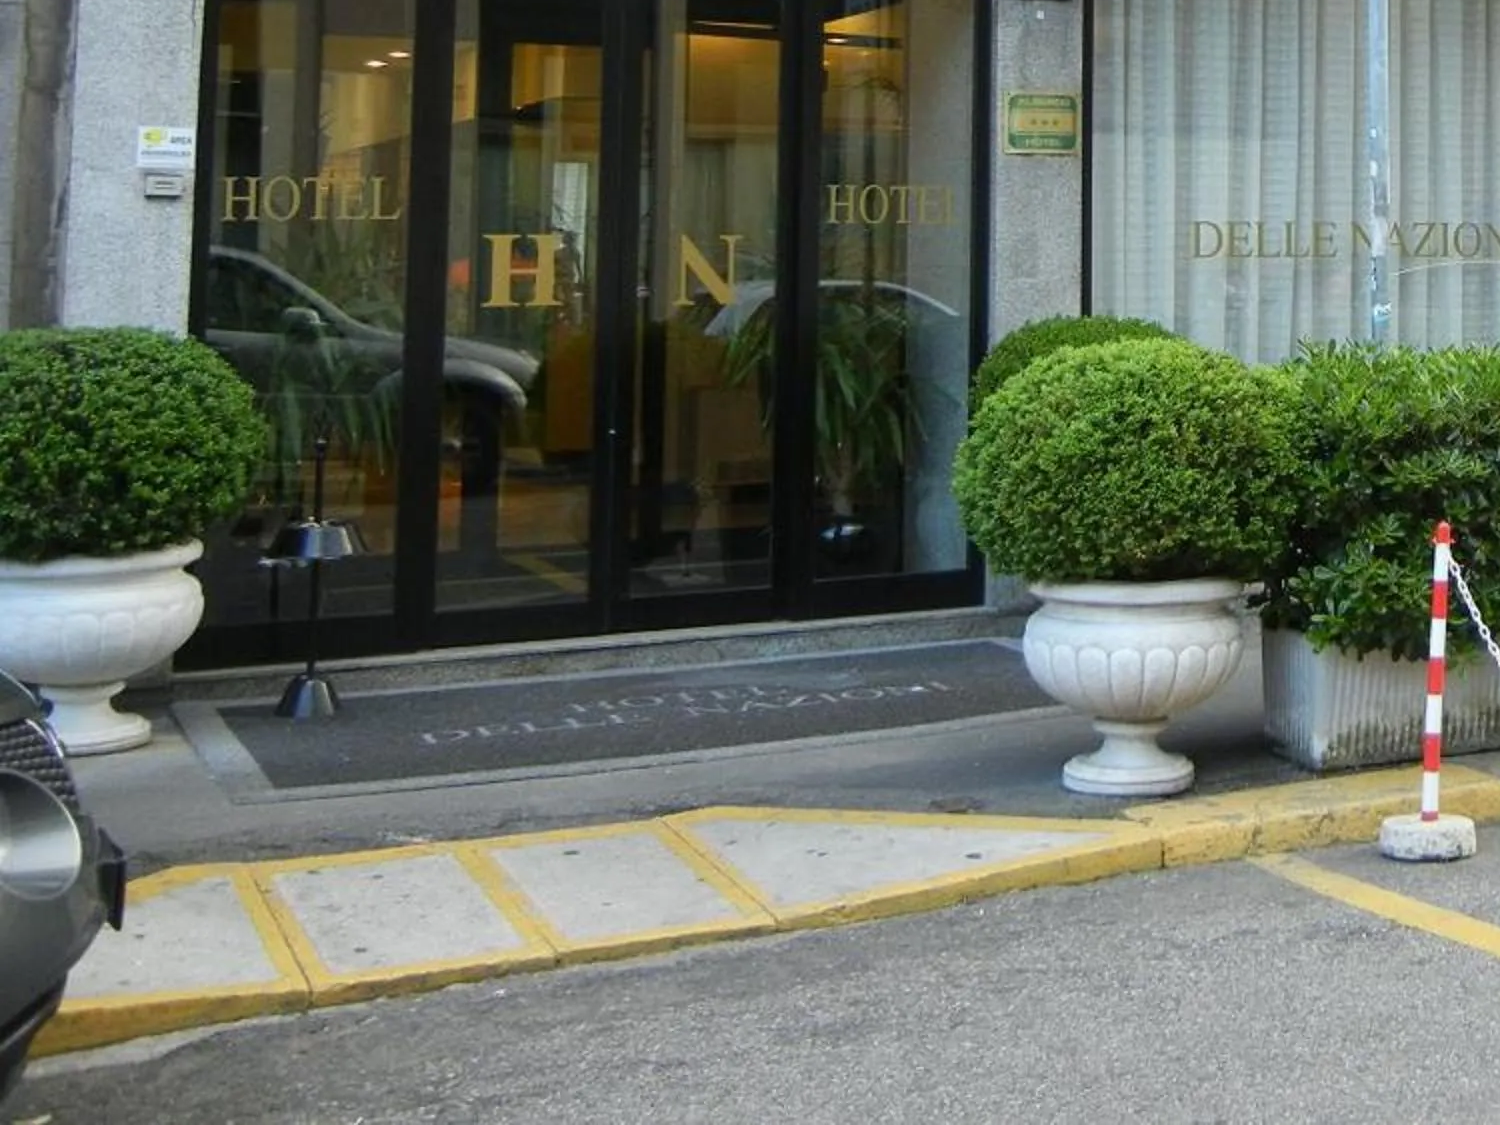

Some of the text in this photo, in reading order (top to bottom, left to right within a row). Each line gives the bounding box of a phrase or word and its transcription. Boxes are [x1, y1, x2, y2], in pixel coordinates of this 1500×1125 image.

[221, 176, 402, 222] HOTEL
[826, 184, 957, 224] HOTEL
[1192, 220, 1338, 259] DELLE
[479, 234, 743, 307] H N
